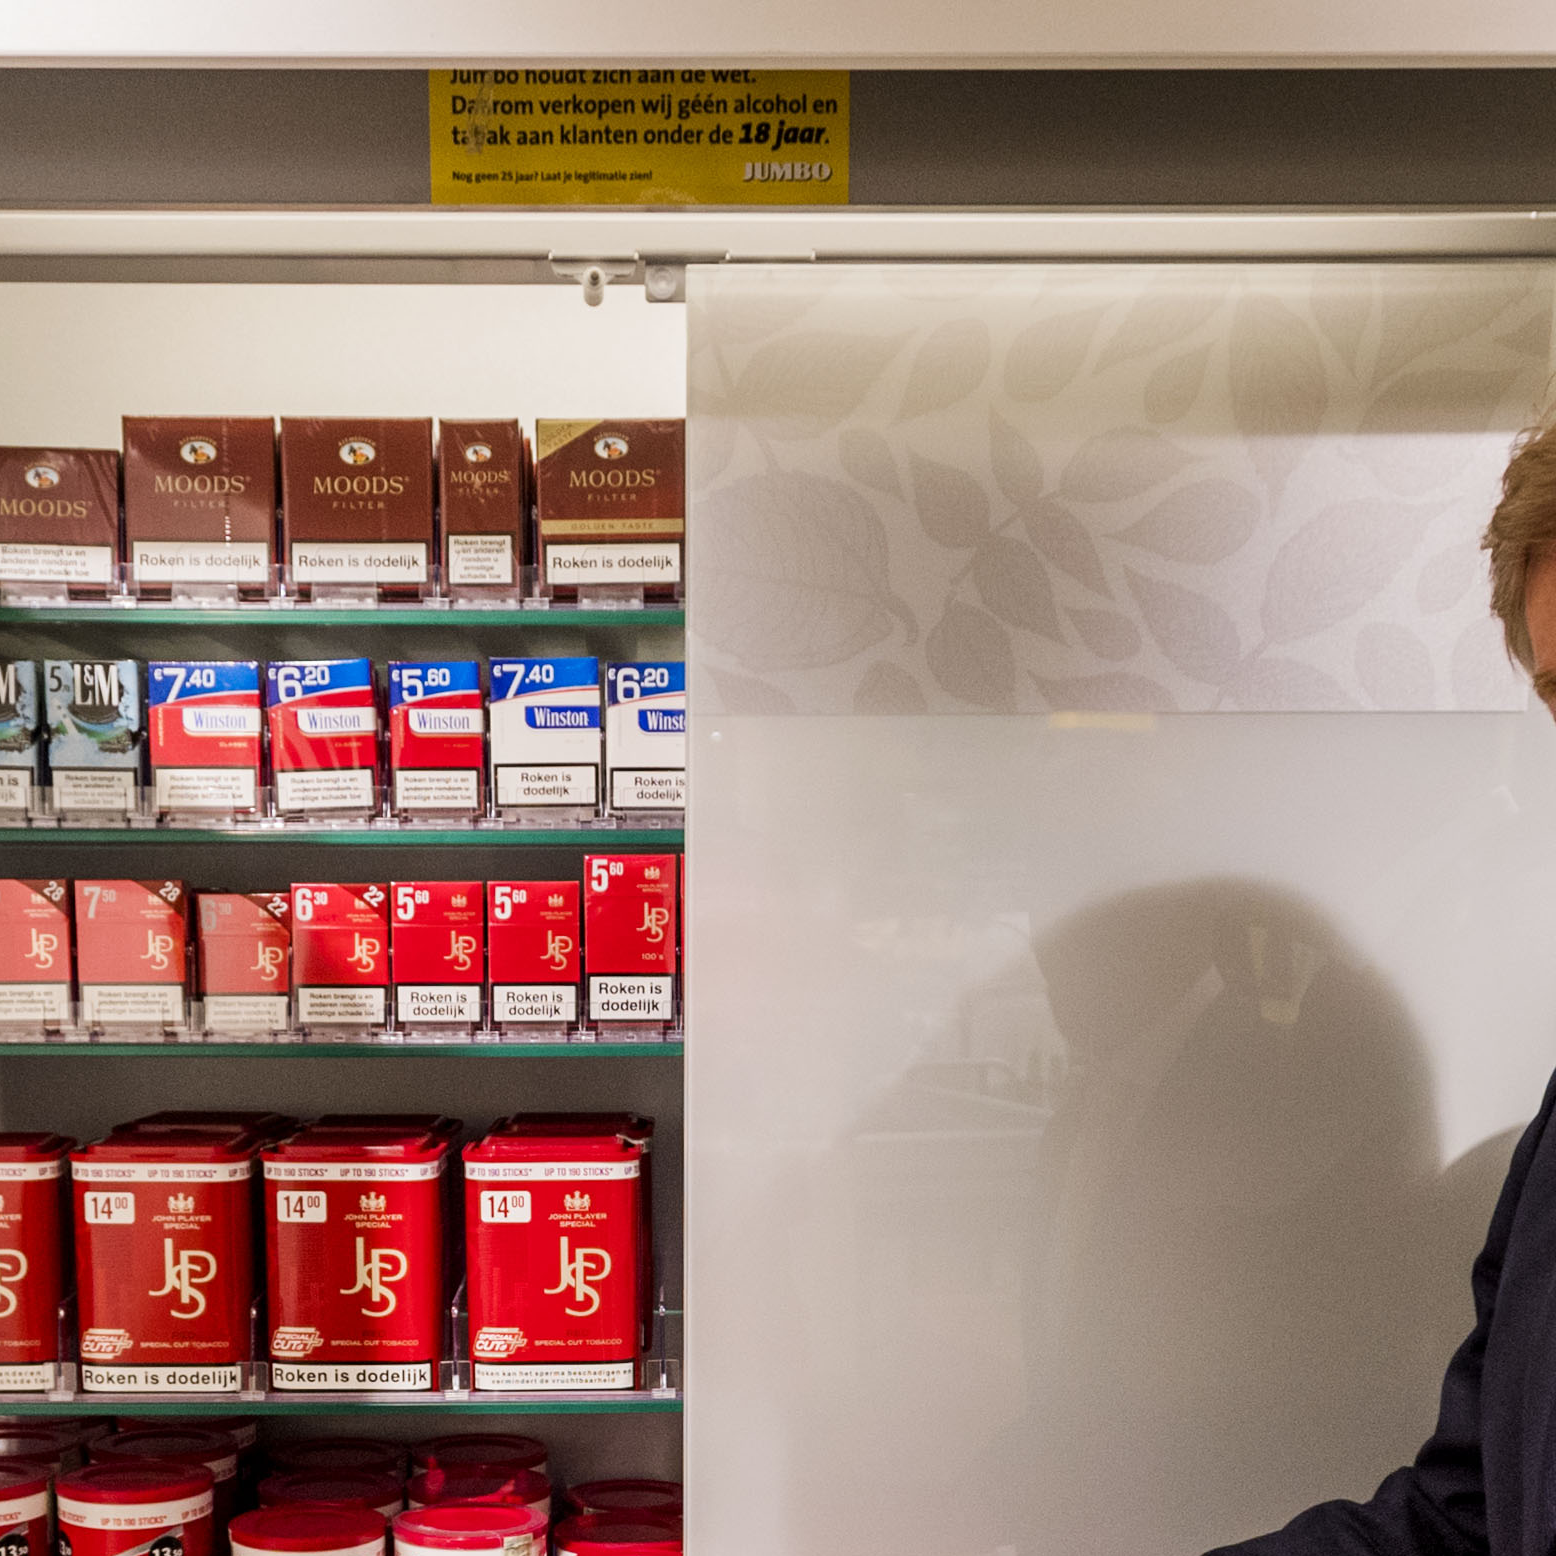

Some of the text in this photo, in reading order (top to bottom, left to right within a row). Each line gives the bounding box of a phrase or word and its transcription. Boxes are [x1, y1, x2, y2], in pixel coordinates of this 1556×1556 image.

[525, 69, 586, 84] houdt
[593, 69, 631, 84] zich
[638, 69, 675, 84] aan
[681, 69, 707, 84] de
[711, 69, 757, 84] wet.
[451, 93, 837, 121] Darom verkopen wij géén alcohol en
[452, 122, 830, 151] taak aan klanten onder de 18 jaar.
[452, 170, 653, 183] Nog geen 25 jaar? Laat je legitimatie zien!
[743, 162, 833, 183] JUMBO
[154, 476, 246, 494] MOODS
[313, 476, 404, 495] MOODS
[450, 471, 509, 484] MOODS
[570, 470, 656, 487] MOODS
[0, 499, 87, 518] MOODS
[332, 502, 385, 510] FILTER
[139, 553, 261, 570] Roken is dodelijk
[299, 555, 420, 571] Roken is dodelijk
[552, 556, 673, 572] Roken is dodelijk
[73, 664, 120, 706] L&M
[154, 667, 215, 703] €7.40
[268, 666, 330, 703] €6.20
[392, 668, 450, 702] €5.60
[493, 664, 554, 699] €7.40
[608, 667, 669, 704] €6.20
[193, 711, 247, 729] Winston
[307, 712, 361, 730] Winston
[416, 711, 470, 730] Winston
[534, 707, 589, 728] Winston
[7, 773, 19, 786] is
[520, 772, 572, 783] Roken is
[634, 777, 685, 787] Roken is
[523, 785, 569, 797] dodelijk
[636, 789, 682, 800] dodelijk
[598, 982, 662, 995] Roken is
[410, 991, 467, 1004] Roken is
[506, 991, 563, 1004] Roken is
[412, 1005, 465, 1018] dodelijk
[508, 1005, 561, 1017] dodelijk
[601, 999, 660, 1013] dodelijk
[91, 1196, 113, 1220] 14
[283, 1196, 305, 1219] 14
[487, 1196, 509, 1219] 14
[152, 1215, 212, 1223] JOHN PLAYER
[344, 1213, 403, 1222] JOHN PLAYER
[548, 1212, 607, 1221] JOHN PLAYER
[559, 1220, 596, 1228] SPECIAL
[163, 1222, 200, 1230] SPECIAL
[354, 1221, 392, 1229] SPECIAL
[330, 1339, 361, 1347] SPECIAL
[363, 1339, 381, 1347] CUT
[84, 1370, 237, 1387] Roken is dodelijk
[274, 1368, 428, 1385] Roken is dodelijk
